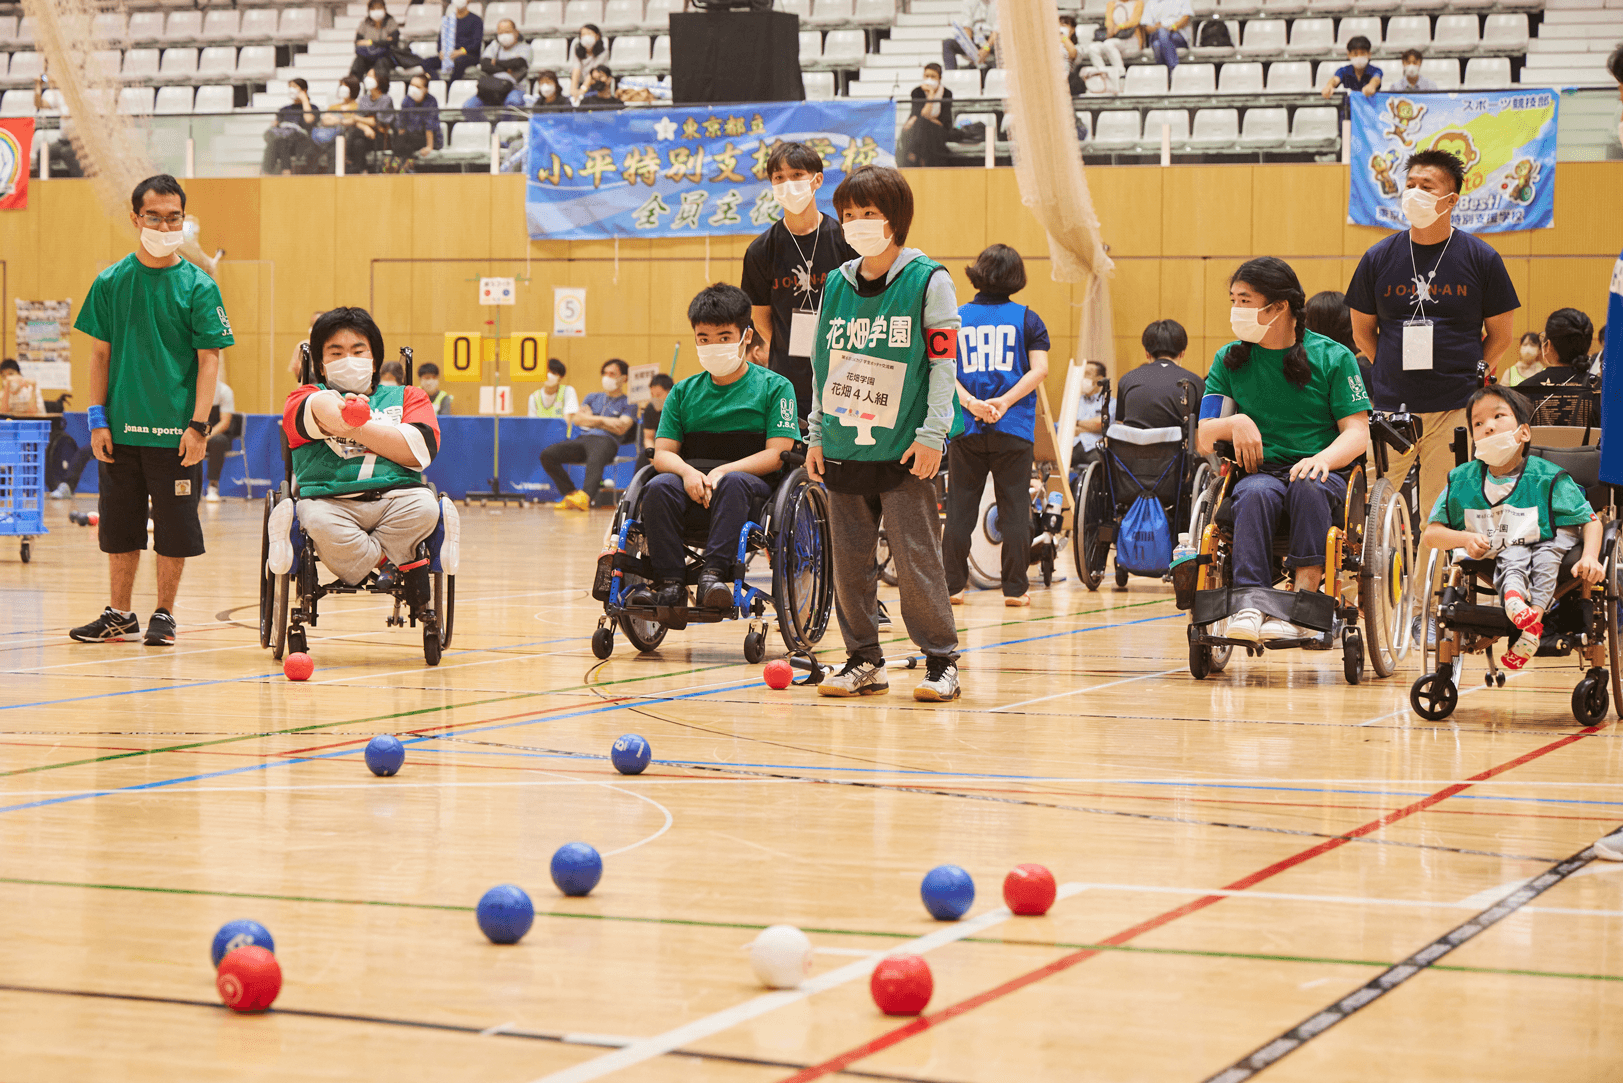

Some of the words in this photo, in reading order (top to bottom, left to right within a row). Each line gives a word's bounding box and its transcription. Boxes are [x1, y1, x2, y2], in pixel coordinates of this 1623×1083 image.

[1462, 94, 1551, 112] スポーツ競技部
[680, 113, 767, 140] 東京都立
[565, 300, 575, 319] 5
[826, 315, 912, 350] 花畑学園
[929, 331, 949, 356] C
[453, 336, 471, 371] 0
[520, 336, 538, 371] 0
[957, 324, 1016, 374] CAC
[499, 390, 506, 411] 1
[123, 422, 150, 434] jonan
[151, 426, 184, 437] sports
